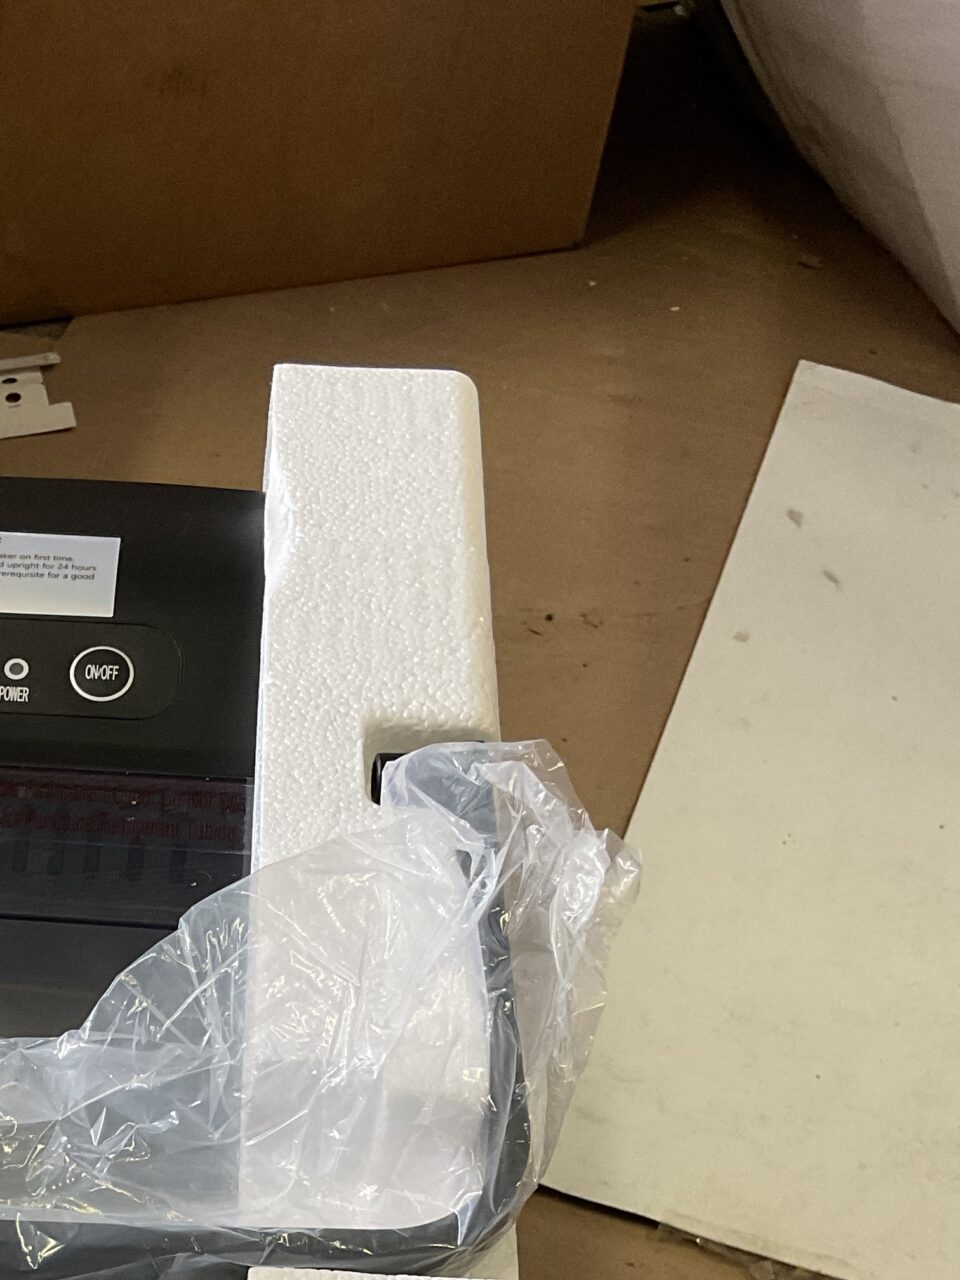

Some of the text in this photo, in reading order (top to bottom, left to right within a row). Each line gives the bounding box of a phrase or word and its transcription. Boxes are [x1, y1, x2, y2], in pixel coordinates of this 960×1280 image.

[33, 553, 51, 561] first
[6, 561, 40, 572] upright
[41, 562, 55, 570] for
[56, 563, 69, 571] 24
[71, 564, 97, 572] hours
[47, 571, 60, 579] for
[70, 572, 96, 581] good
[84, 663, 120, 681] ON/OFF
